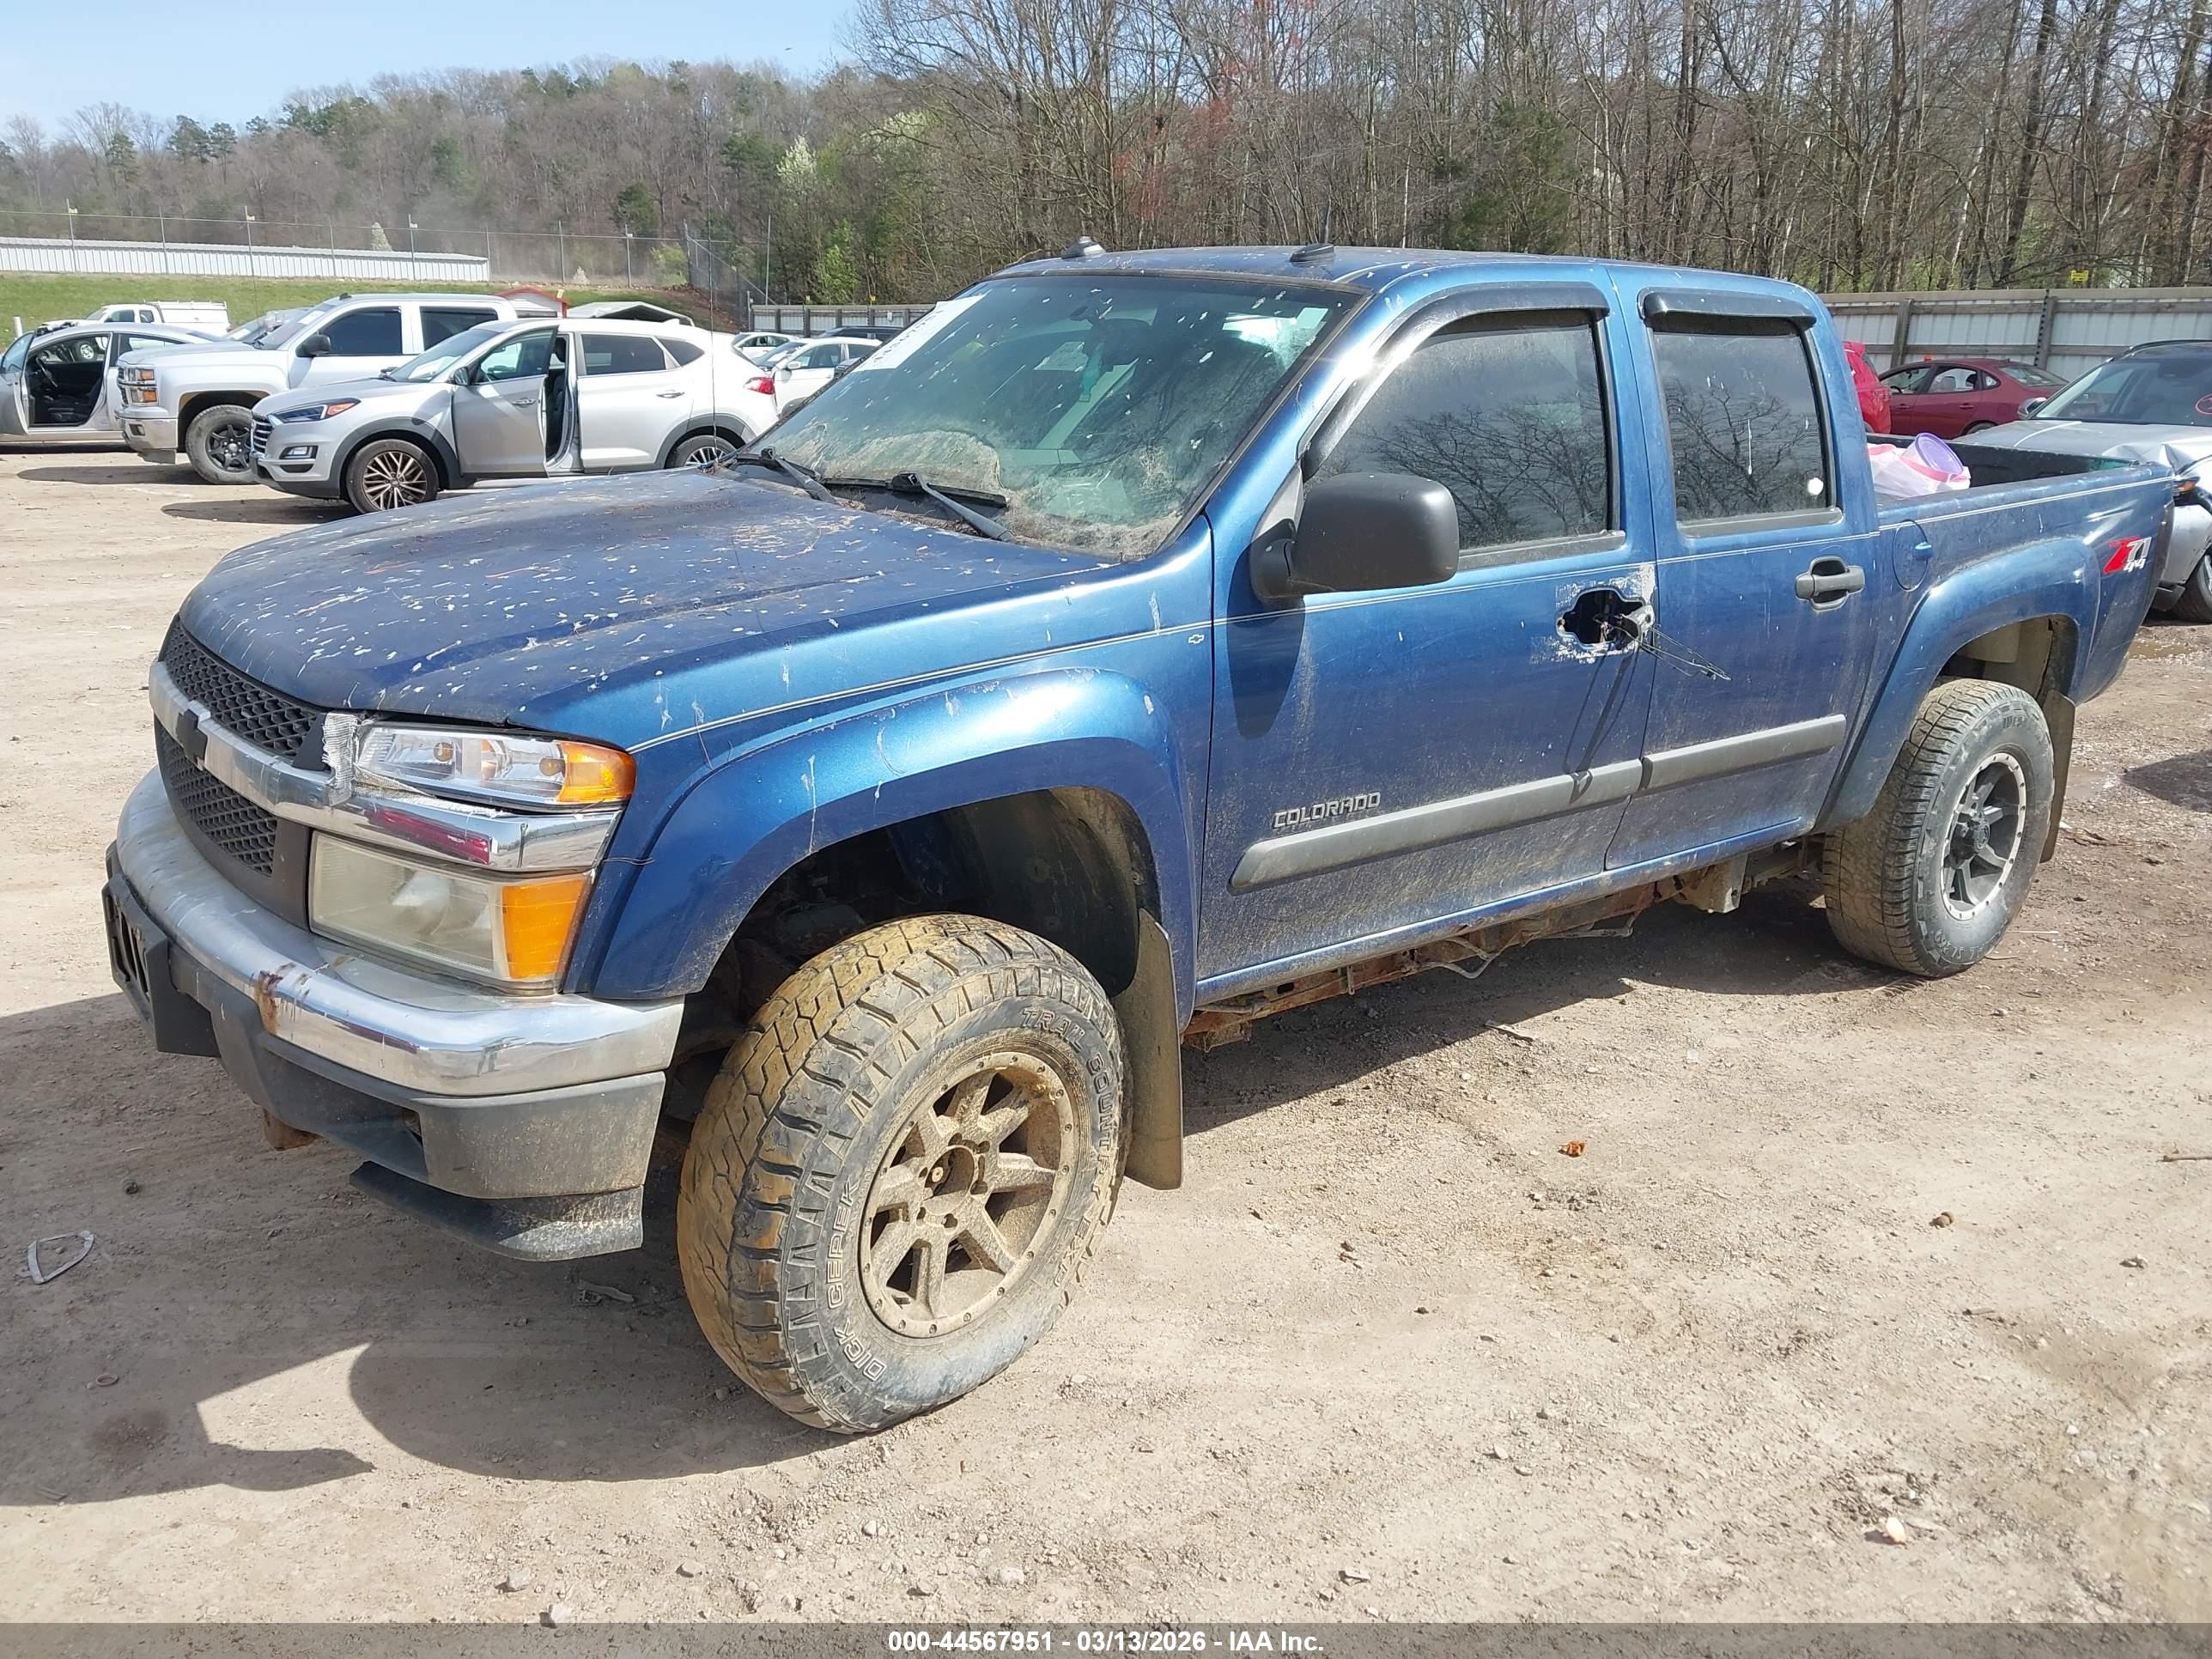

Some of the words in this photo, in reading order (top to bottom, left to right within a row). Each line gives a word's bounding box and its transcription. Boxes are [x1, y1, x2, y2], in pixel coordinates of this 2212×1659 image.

[2103, 536, 2152, 574] Z71
[1273, 792, 1382, 829] COLORADO
[1021, 1008, 1085, 1053] TRAIL
[826, 1176, 859, 1309] CEPEK
[834, 1319, 887, 1382] DICK
